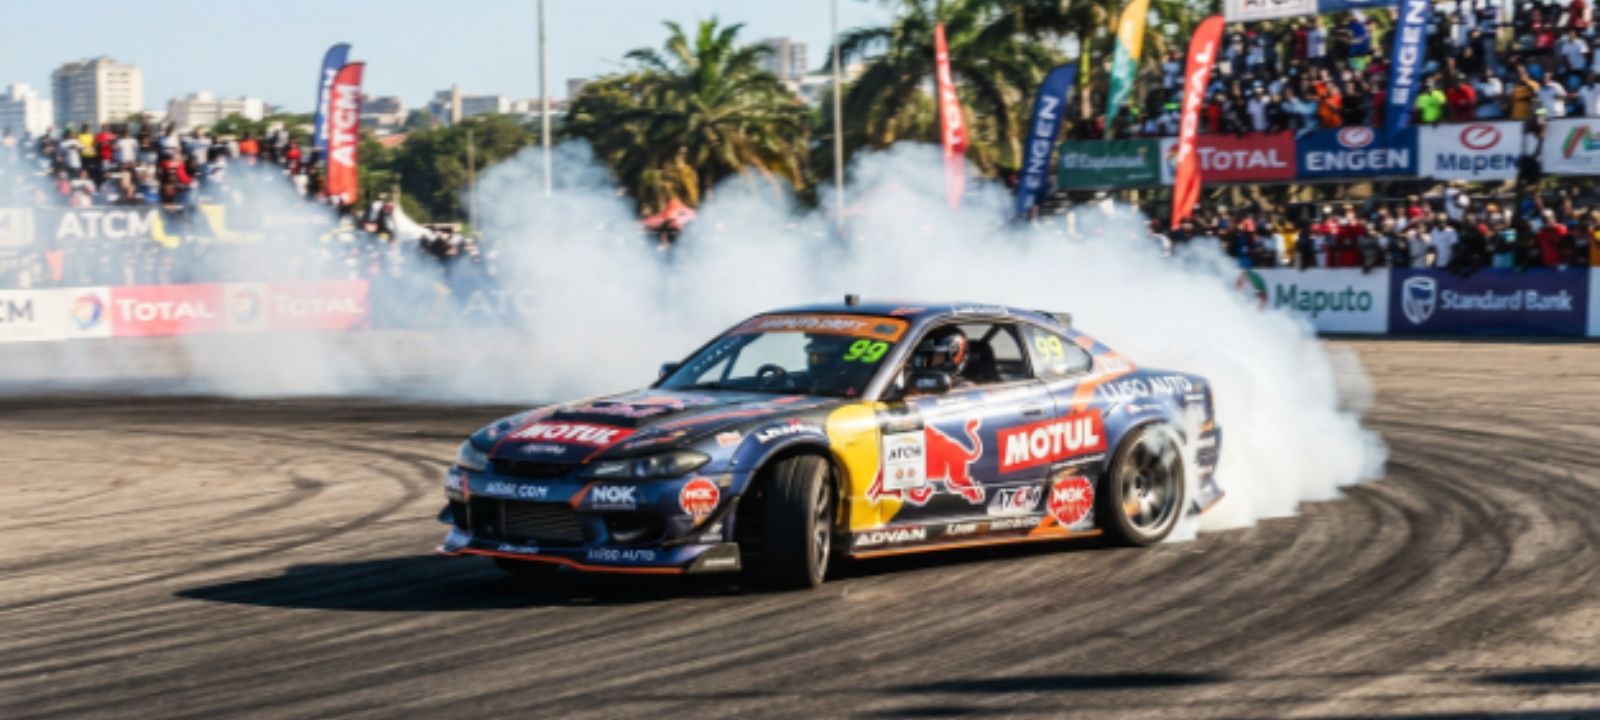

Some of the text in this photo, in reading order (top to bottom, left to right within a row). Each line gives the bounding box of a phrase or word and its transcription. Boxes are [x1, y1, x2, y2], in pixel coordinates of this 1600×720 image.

[332, 83, 358, 168] ATCM
[1025, 95, 1060, 188] ENGEN
[1197, 147, 1287, 170] TOTAL
[1306, 149, 1409, 171] ENGEN
[56, 210, 161, 240] ATCM
[115, 299, 216, 321] TOTAL
[272, 296, 365, 317] TOTAL
[1274, 284, 1373, 316] Maputo
[1440, 288, 1573, 310] Standard Bank
[842, 339, 889, 362] 99
[1033, 334, 1065, 361] 99
[511, 422, 620, 444] MOTUL
[1003, 417, 1099, 466] MOTUL
[854, 527, 926, 546] ADVAN
